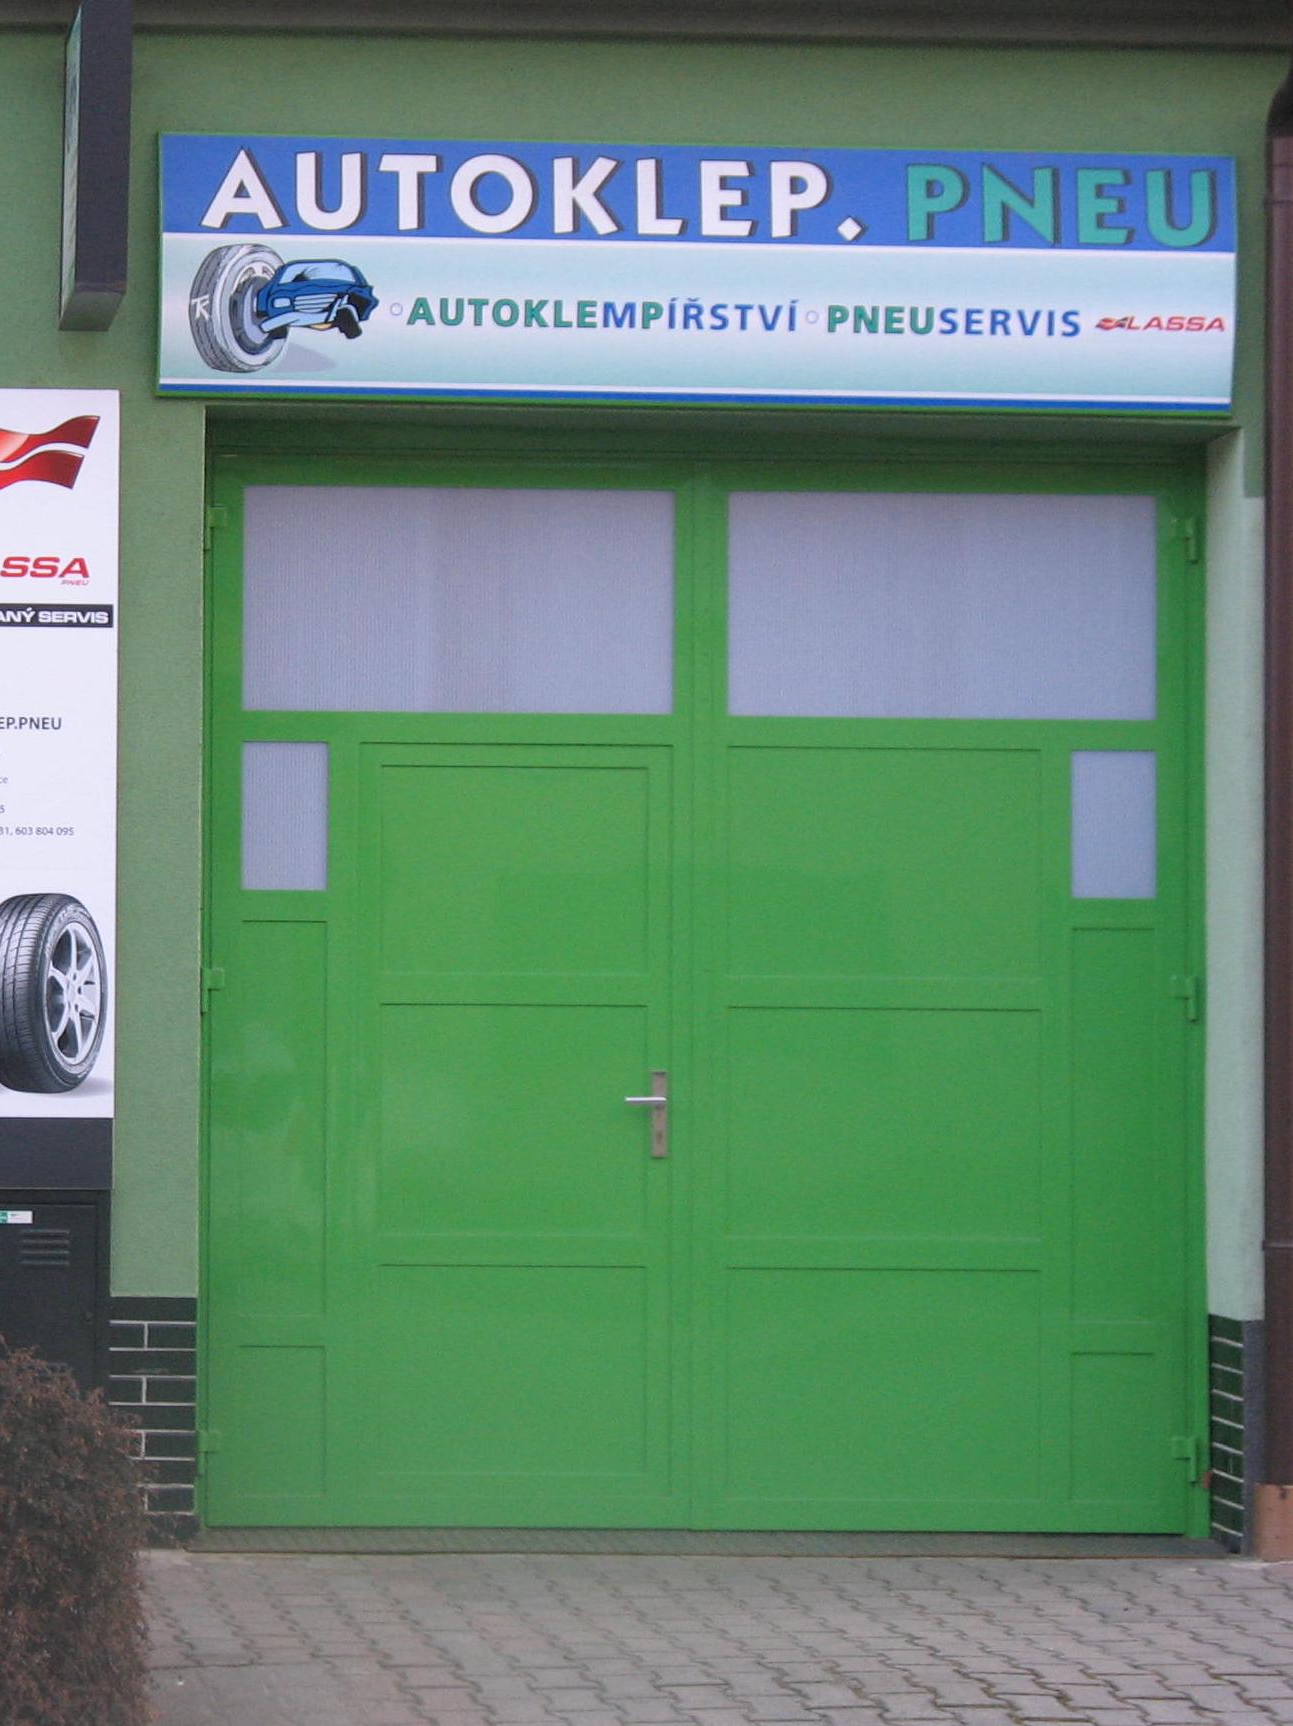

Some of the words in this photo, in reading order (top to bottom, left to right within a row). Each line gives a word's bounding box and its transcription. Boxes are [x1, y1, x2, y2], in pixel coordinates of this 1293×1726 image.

[200, 149, 863, 241] AUTOKLEP.
[906, 162, 1218, 248] PNEU
[407, 297, 799, 331] AUTOKLEMPÍŘSTVÍ
[827, 304, 1081, 337] PNEUSERVIS
[1125, 316, 1226, 332] LASSA
[38, 611, 109, 625] SERVIS
[14, 826, 33, 836] 603
[35, 827, 54, 836] 804
[56, 827, 75, 836] 095
